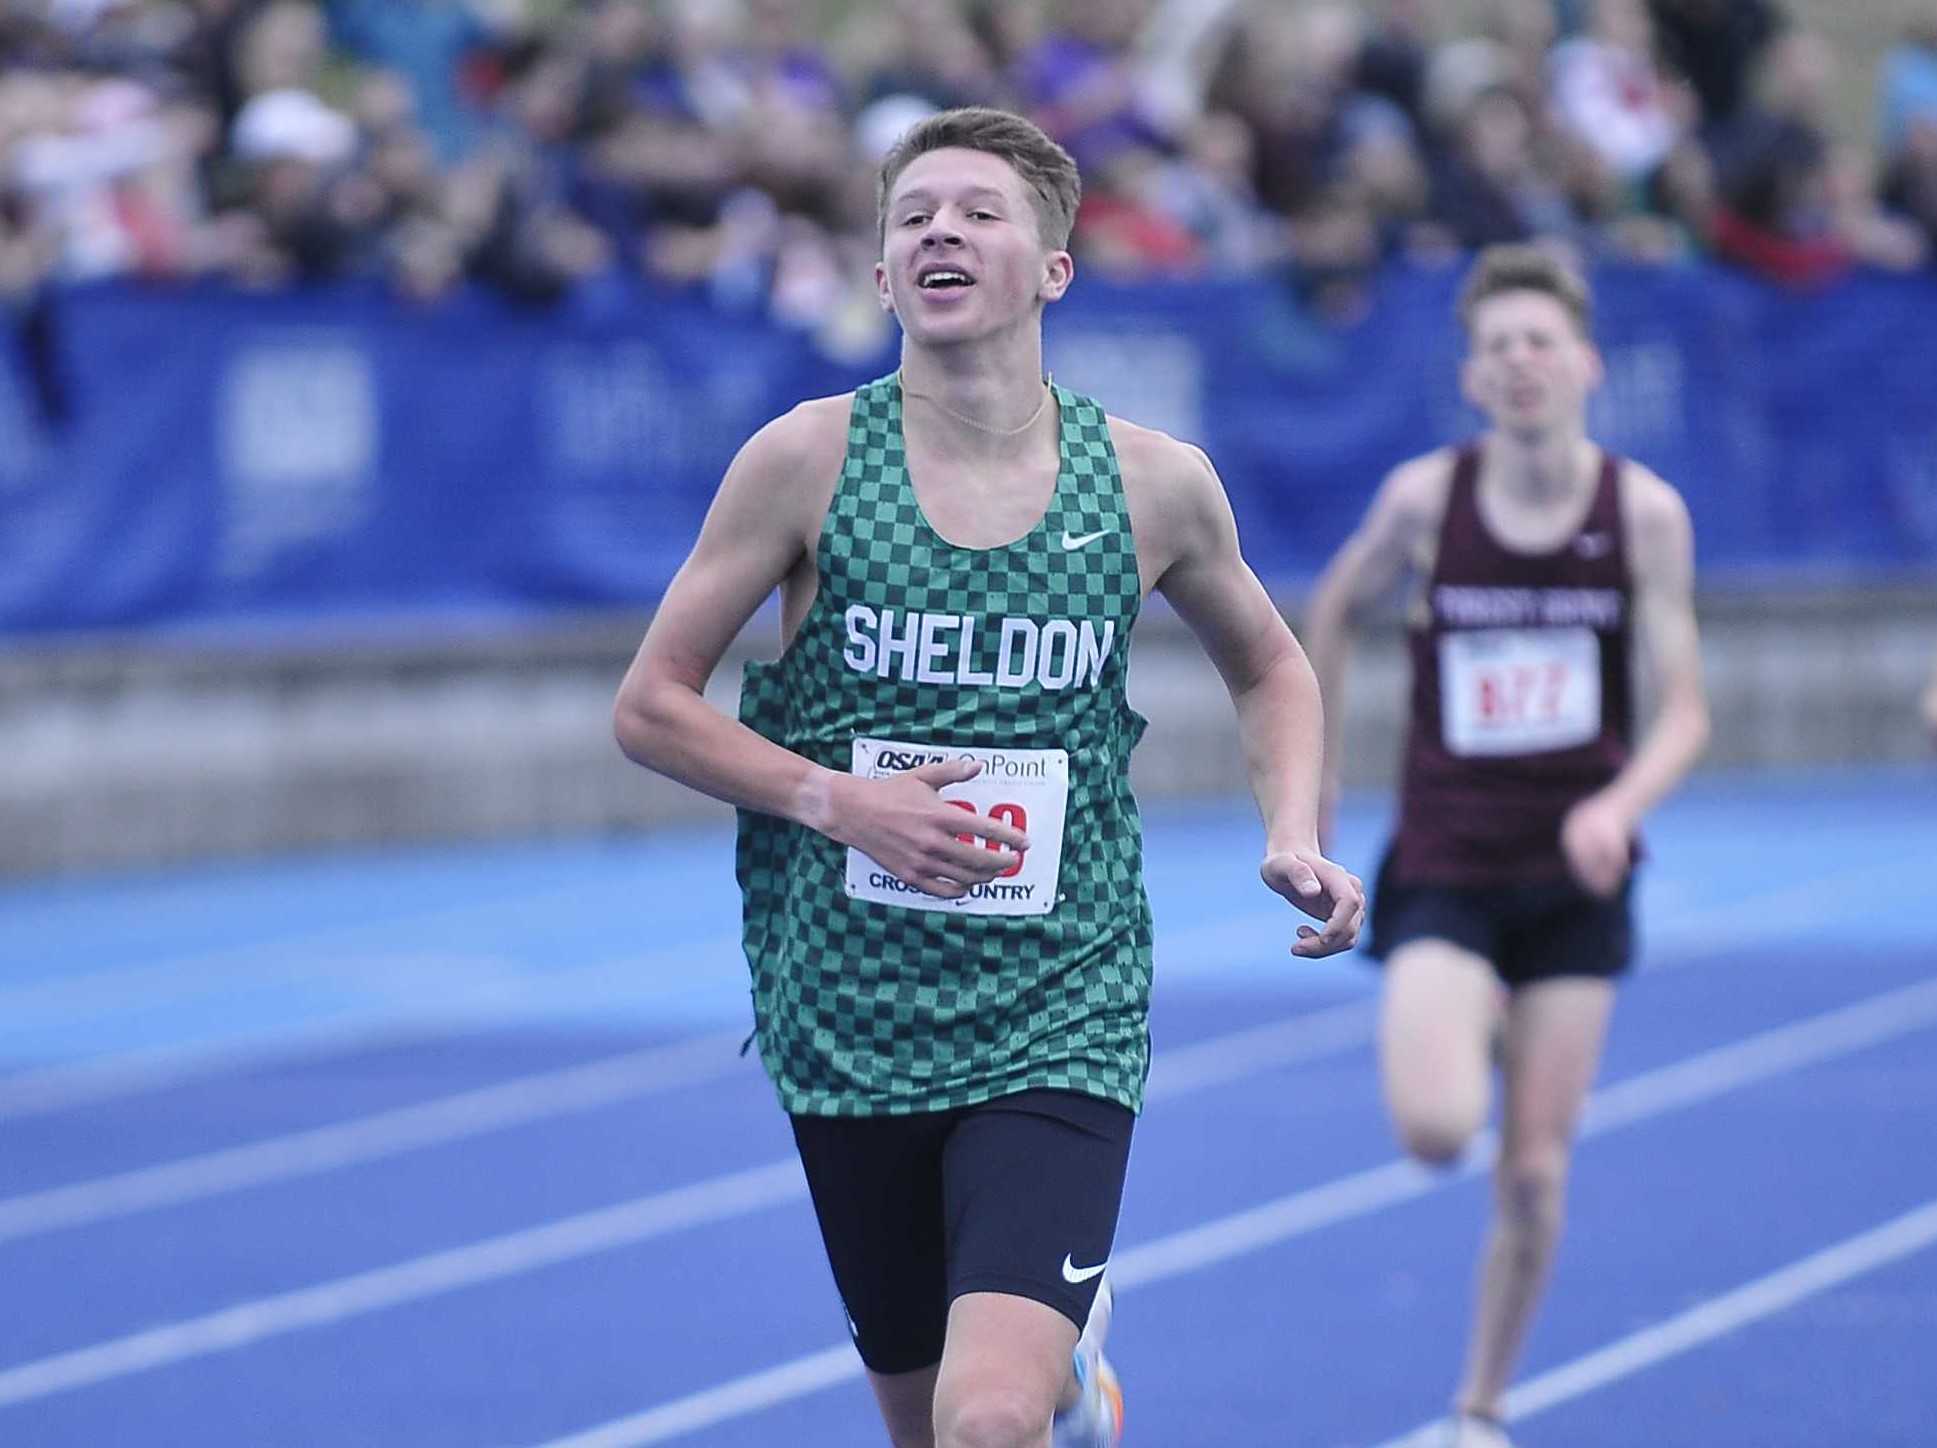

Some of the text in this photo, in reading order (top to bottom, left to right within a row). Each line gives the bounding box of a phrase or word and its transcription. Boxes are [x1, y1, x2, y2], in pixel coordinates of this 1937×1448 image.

[844, 604, 1114, 690] SHELDON
[869, 873, 1035, 900] CRO UNTRY
